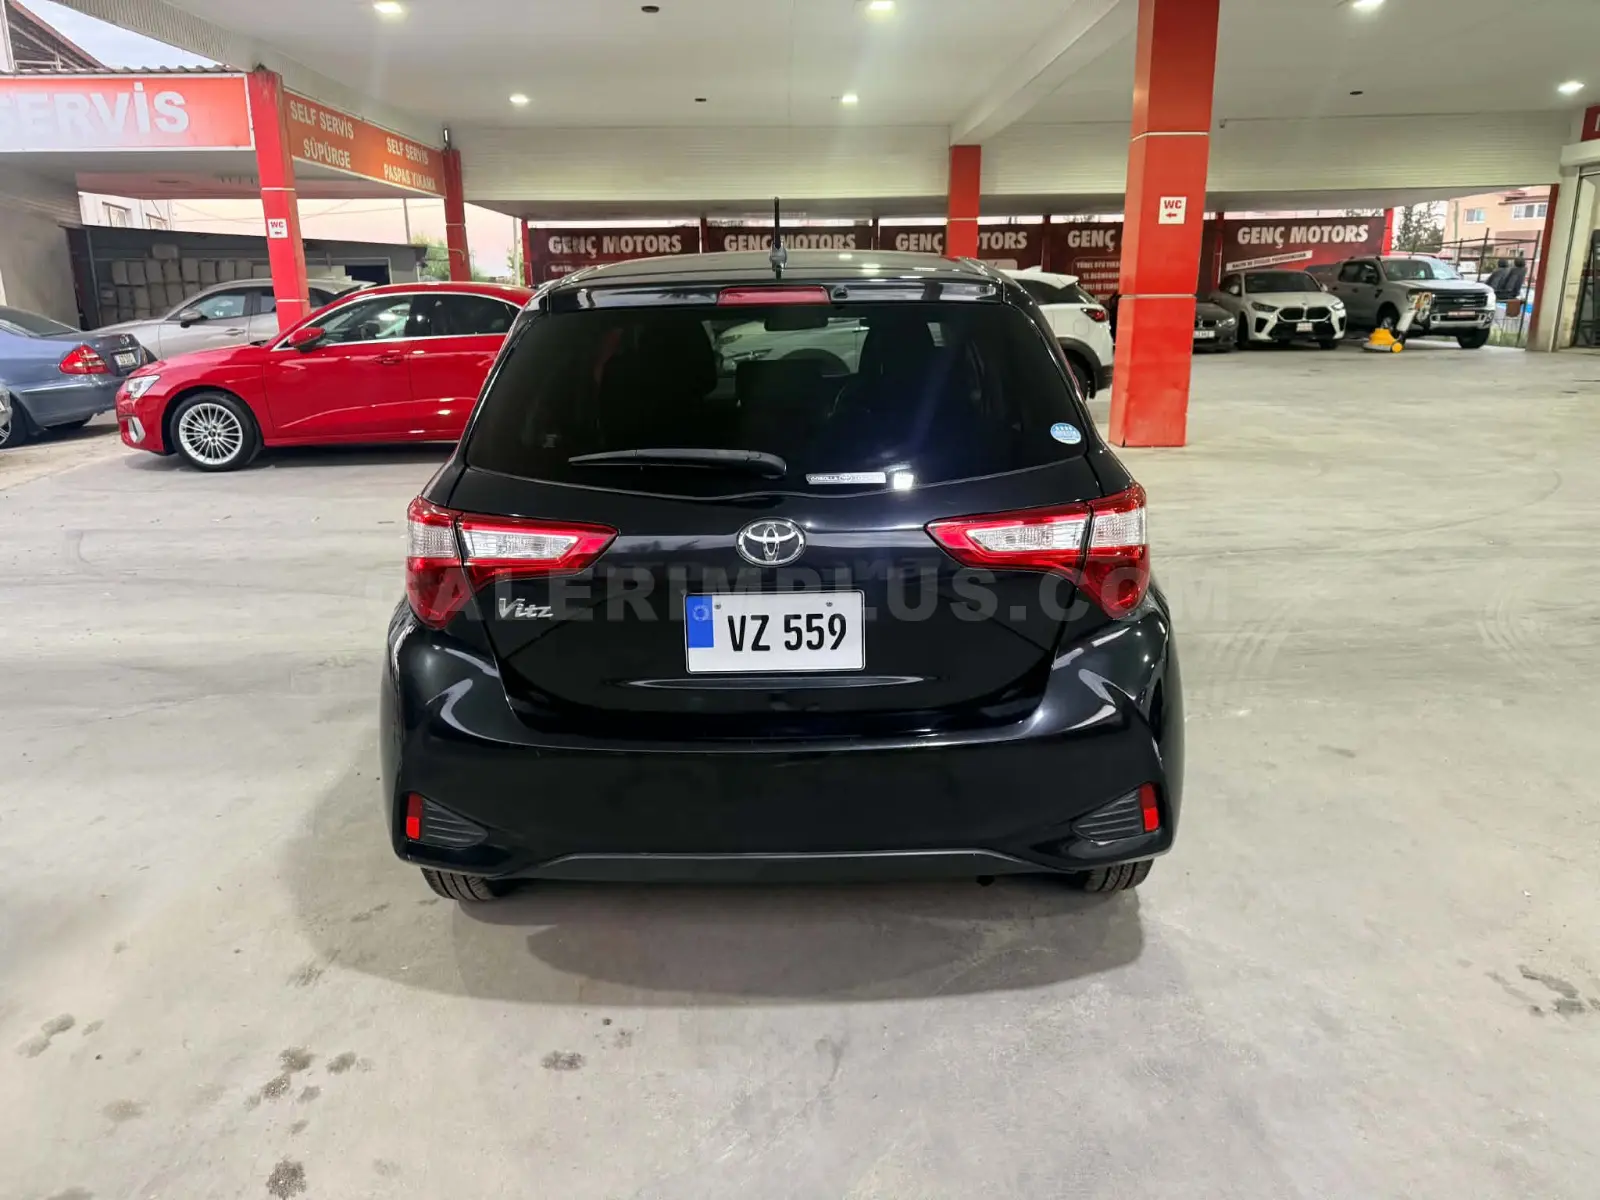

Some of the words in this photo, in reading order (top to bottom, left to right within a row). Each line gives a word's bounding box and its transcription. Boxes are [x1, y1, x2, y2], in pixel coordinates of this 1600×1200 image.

[290, 100, 317, 126] SELF
[319, 112, 354, 140] SERVİS
[303, 136, 351, 169] SÜPÜRGE
[386, 136, 404, 157] SELF
[405, 143, 429, 165] SERVİS
[1164, 200, 1182, 209] WC
[548, 235, 597, 259] GENÇ
[602, 234, 682, 254] MOTORS
[779, 233, 856, 250] MOTORS
[895, 233, 944, 255] GENÇ
[976, 231, 1028, 250] TORS
[1067, 229, 1116, 252] GENÇ
[1237, 226, 1285, 249] GENÇ
[1289, 224, 1369, 244] MOTORS
[498, 598, 554, 619] Vitz
[727, 614, 771, 652] VZ
[783, 612, 847, 651] 559
